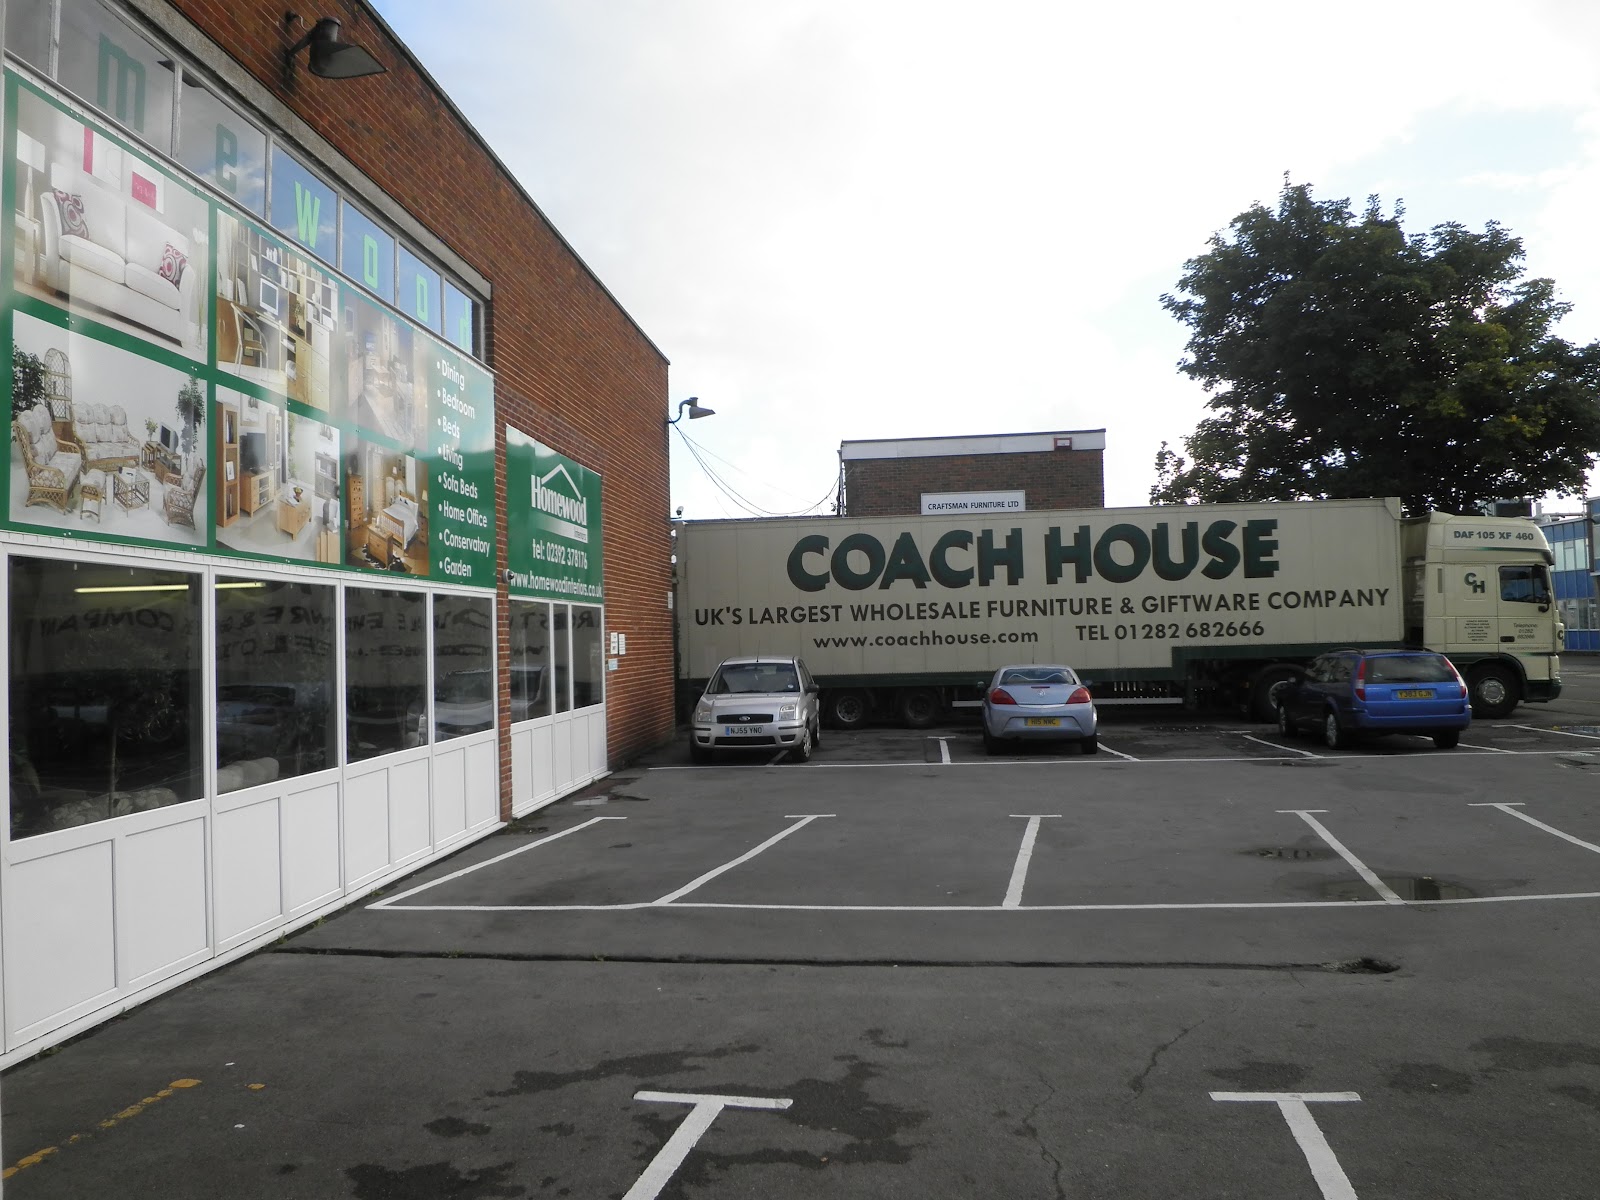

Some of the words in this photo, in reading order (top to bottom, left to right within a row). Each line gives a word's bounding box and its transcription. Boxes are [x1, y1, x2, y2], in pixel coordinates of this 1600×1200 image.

[441, 359, 465, 391] Dining
[442, 388, 475, 420] Bedroom
[442, 416, 460, 439] Beds
[442, 444, 463, 471] Living
[443, 472, 459, 493] Sofa
[459, 475, 478, 499] Beds
[443, 500, 465, 521] Home
[466, 505, 488, 528] Office
[531, 474, 587, 526] Homewood
[928, 502, 968, 510] CRAFTSMAN
[970, 501, 1005, 509] FURNITURE
[1007, 500, 1019, 508] LTD
[443, 528, 490, 557] Conservatory
[1454, 531, 1474, 539] DAF
[1476, 531, 1495, 539] 105
[1498, 532, 1512, 540] XF
[1515, 532, 1534, 541] 460
[444, 557, 472, 578] Garden
[532, 538, 545, 560] tel:
[546, 541, 566, 565] 02392
[567, 547, 588, 569] 378176
[786, 527, 1024, 592] COACH
[1044, 519, 1280, 585] HOUSE
[510, 570, 603, 598] www.homewoodinteriors.co.uk
[694, 606, 743, 626] UK'S
[749, 605, 843, 625] LARGEST
[850, 601, 981, 622] WHOLESALE
[987, 597, 1112, 618] FURNITURE
[1119, 597, 1135, 614] &
[1141, 592, 1260, 614] GIFTWARE
[1267, 588, 1390, 610] COMPANY
[813, 629, 1039, 649] www.coachhouse.com
[1075, 625, 1109, 641] TEL
[1114, 623, 1180, 640] 01282
[1185, 620, 1265, 639] 682666
[749, 726, 762, 734] YNO
